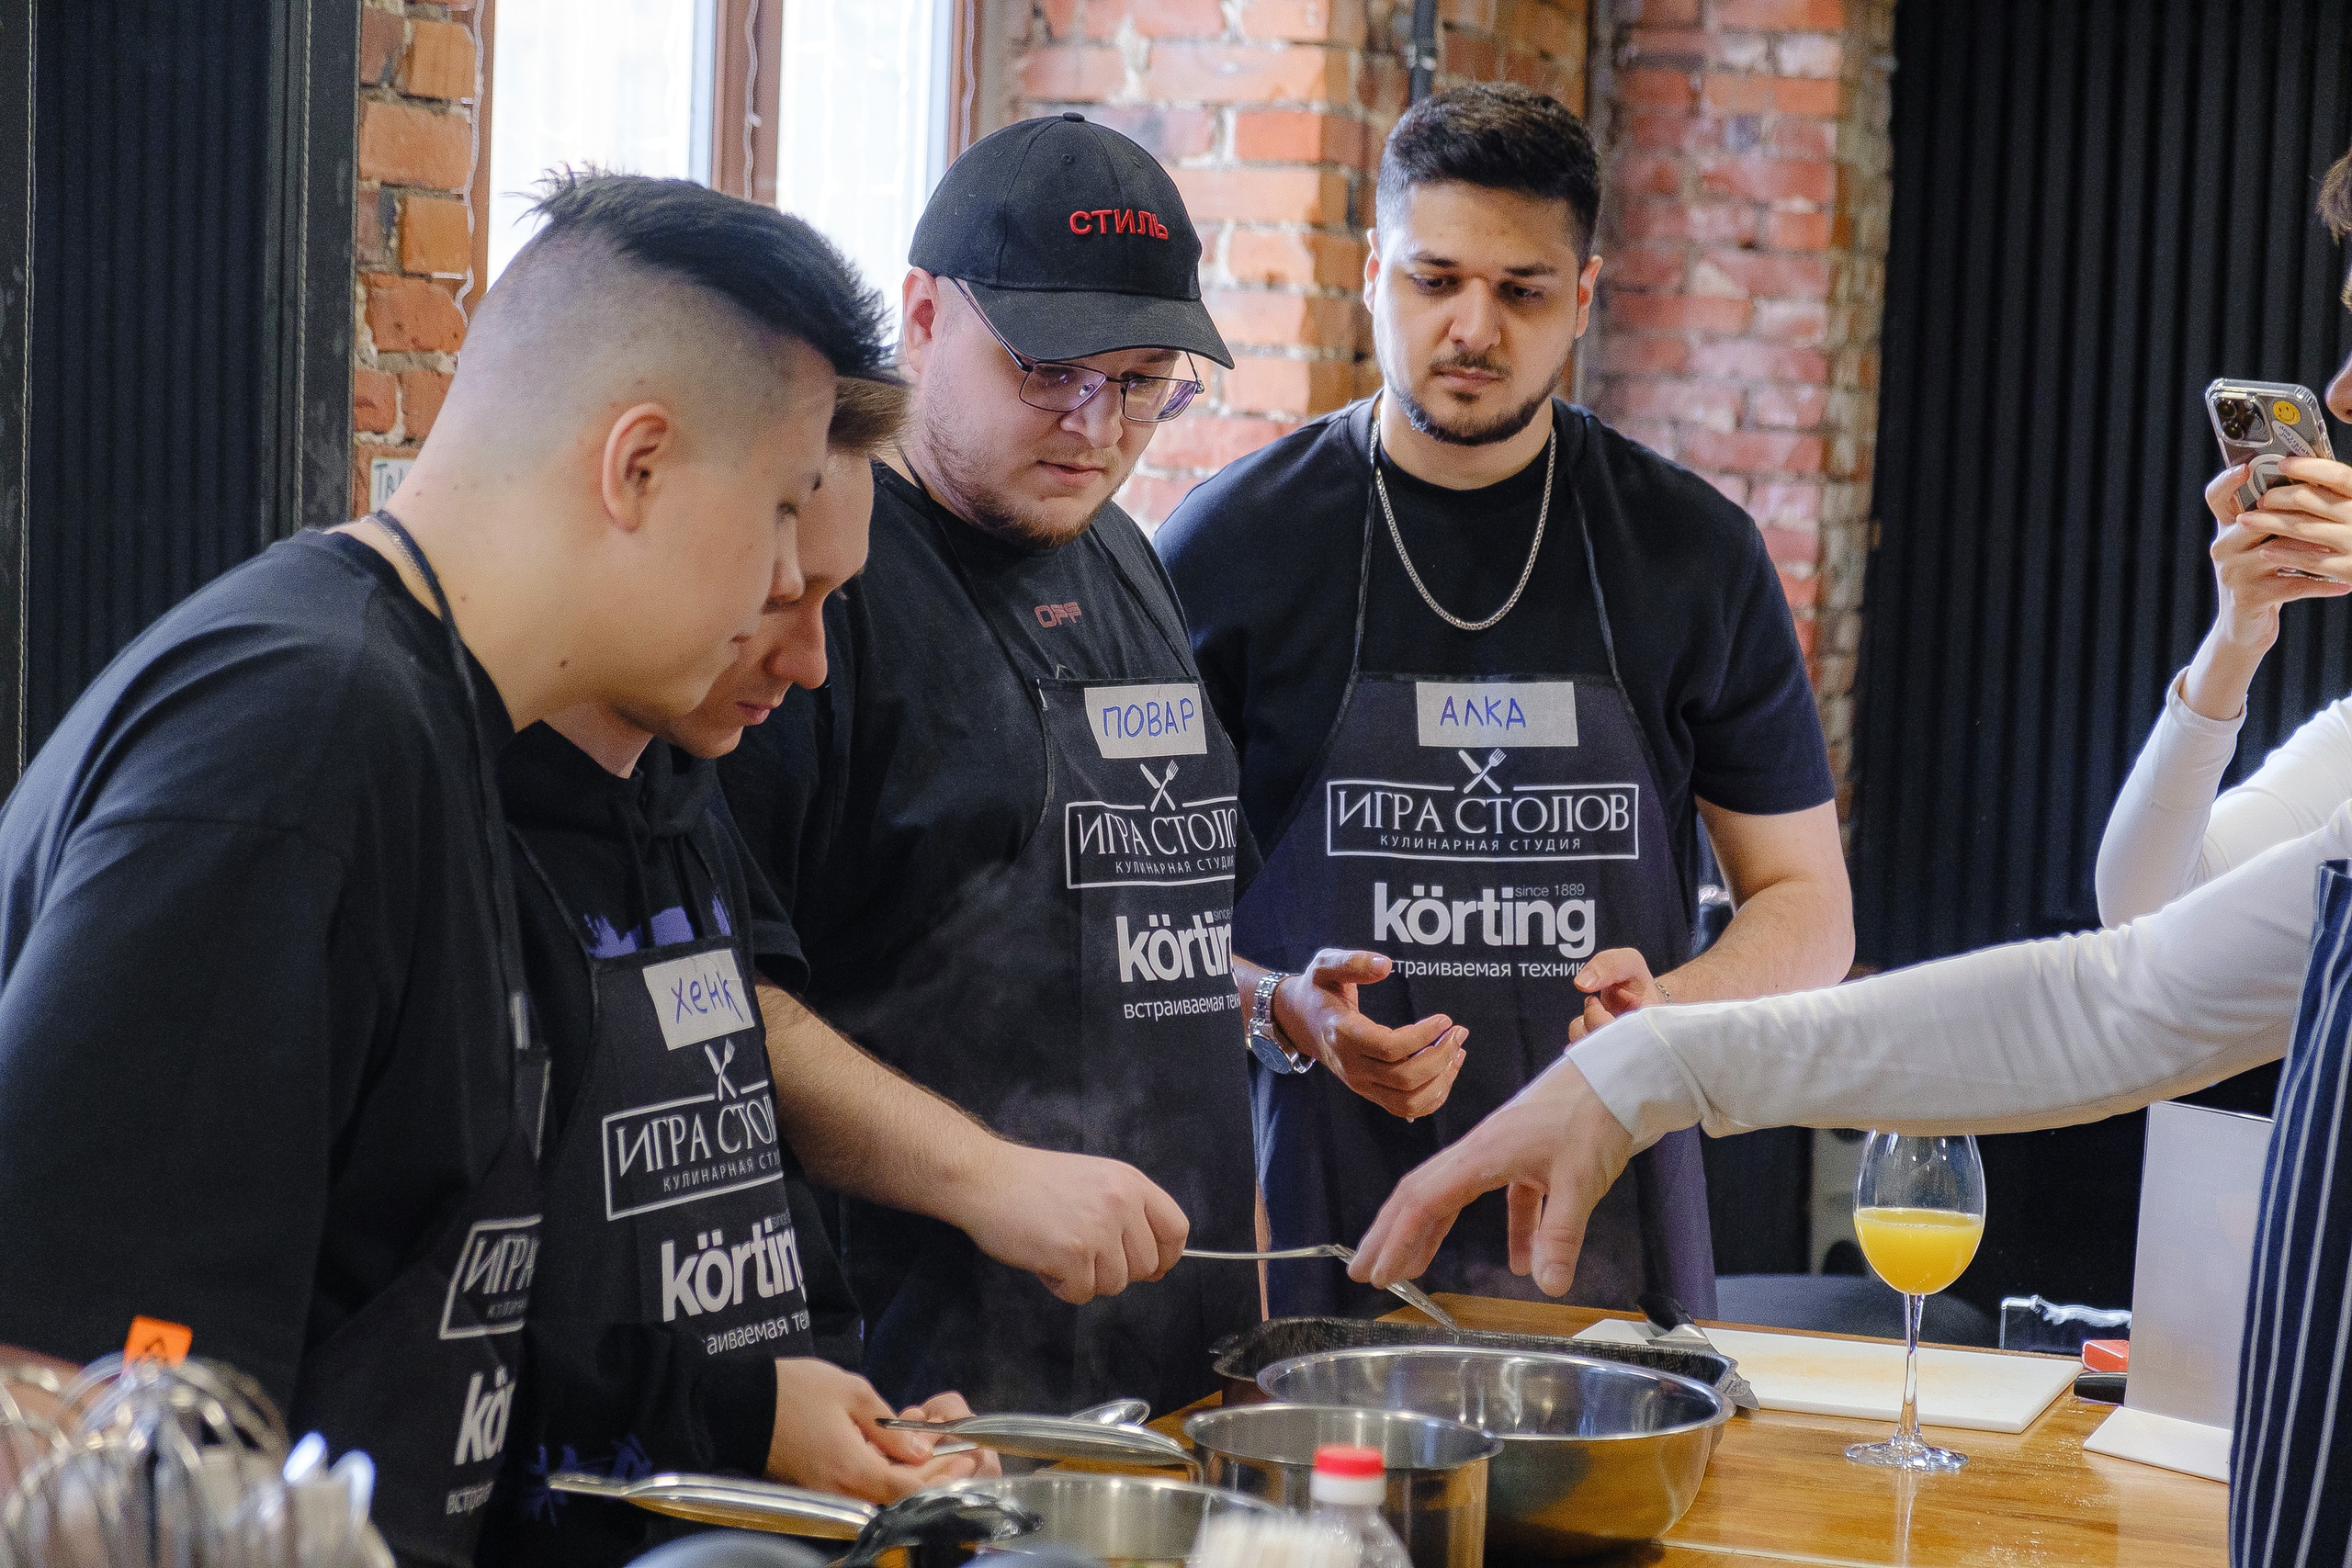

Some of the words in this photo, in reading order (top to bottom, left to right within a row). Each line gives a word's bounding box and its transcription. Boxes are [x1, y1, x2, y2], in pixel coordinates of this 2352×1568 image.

[1069, 209, 1169, 241] СТИЛЬ
[1035, 601, 1082, 628] OFF
[1102, 697, 1195, 739] ПОВАР
[1440, 695, 1527, 731] АЛКА
[1338, 791, 1445, 833] ИГРА
[1454, 794, 1631, 835] СТОЛОВ
[1077, 812, 1152, 856] ИГРА
[1380, 834, 1500, 852] КУЛИНАРНАЯ
[1510, 837, 1581, 852] СТУДИЯ
[1115, 861, 1193, 874] КУЛИНАРНАЯ
[1514, 884, 1550, 897] since
[1554, 883, 1586, 897] 1889
[1374, 882, 1596, 959] körting
[1115, 910, 1238, 987] körtin
[1124, 995, 1225, 1022] встраиваемая
[616, 1112, 712, 1178] ИГРА
[663, 1157, 754, 1192] КУЛИНАРНАЯ
[662, 1215, 807, 1323] körtin
